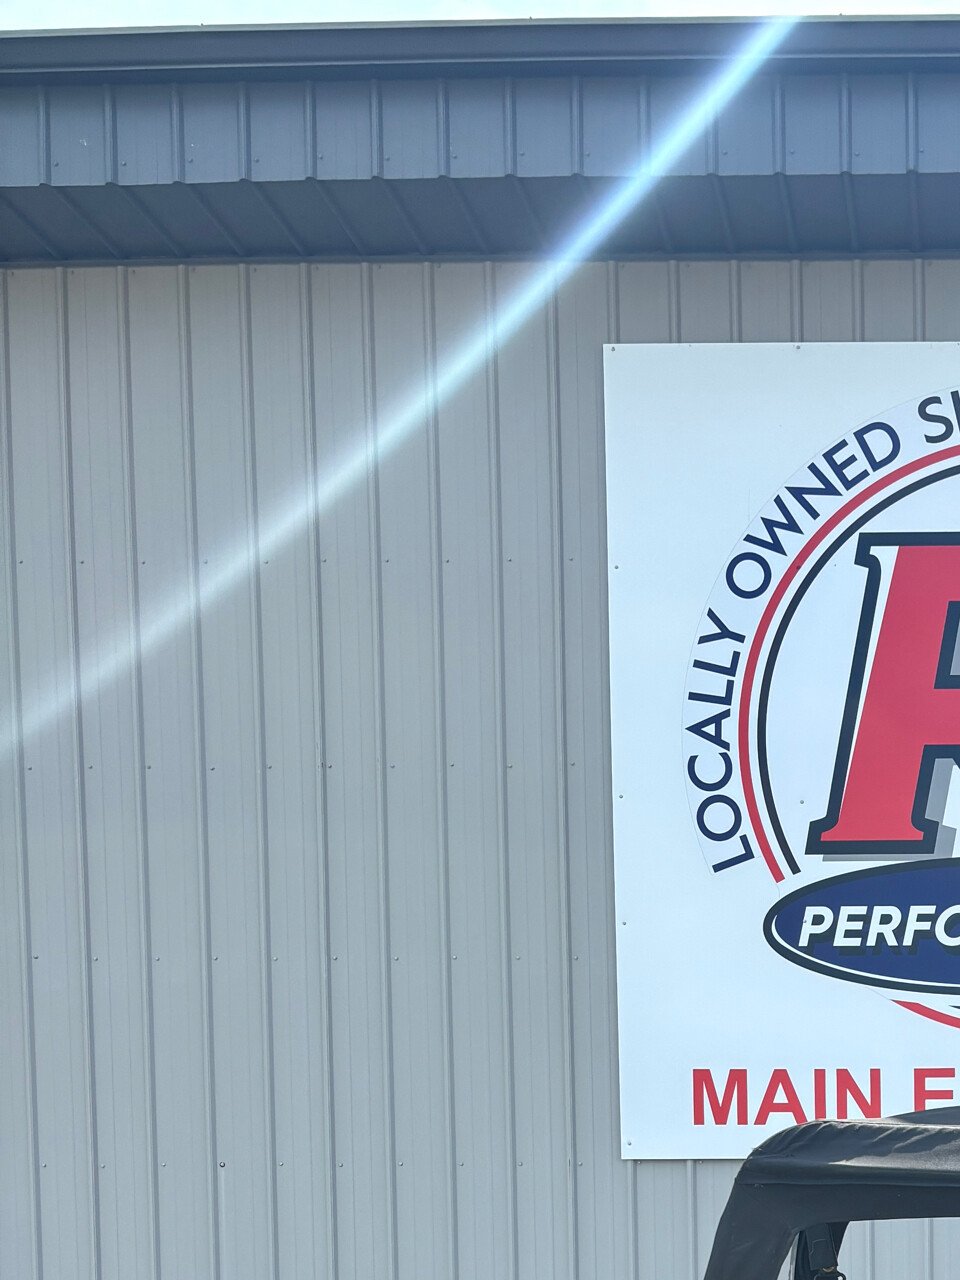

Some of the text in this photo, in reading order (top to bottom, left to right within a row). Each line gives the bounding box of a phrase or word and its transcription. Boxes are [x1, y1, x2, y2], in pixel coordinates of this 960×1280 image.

[685, 607, 755, 874] LOCALLY
[725, 422, 901, 600] OWNED
[692, 1069, 882, 1126] MAIN
